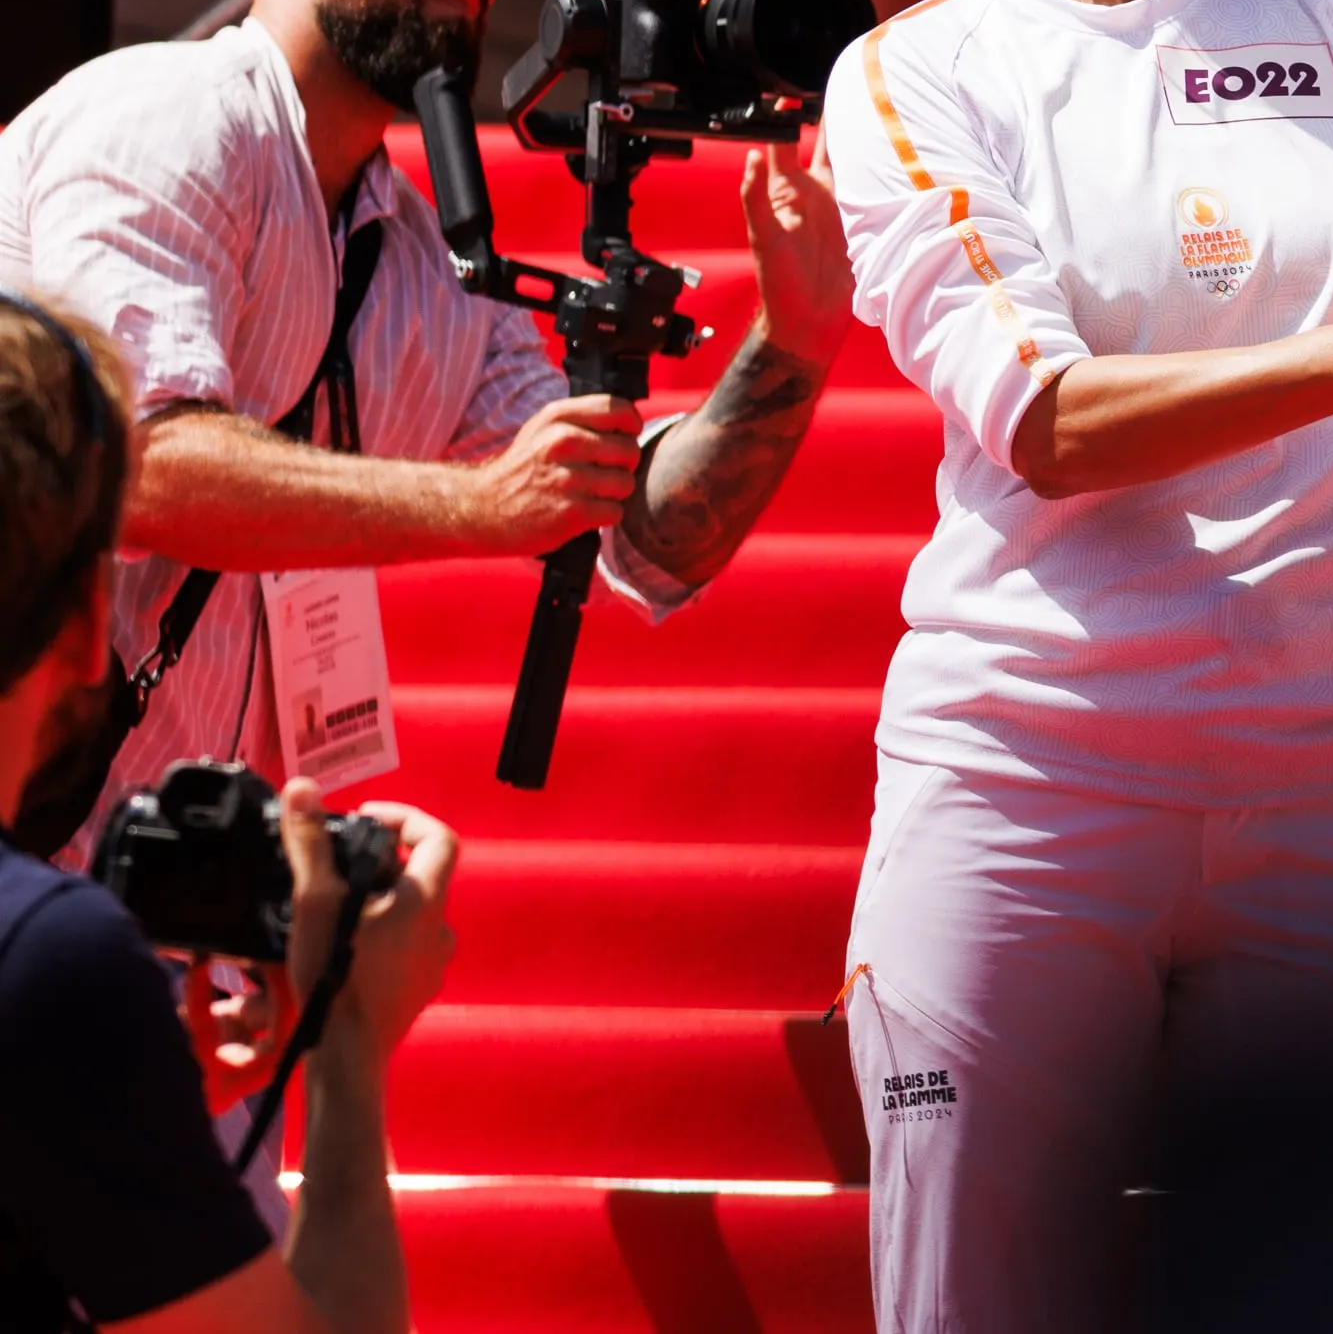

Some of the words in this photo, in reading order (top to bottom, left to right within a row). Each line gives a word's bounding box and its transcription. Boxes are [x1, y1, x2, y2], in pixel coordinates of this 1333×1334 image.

[1184, 61, 1321, 103] EO22
[1182, 231, 1223, 245] RELAIS
[1226, 228, 1242, 240] DE
[1180, 245, 1194, 257] LA
[1197, 238, 1249, 255] FLAMME
[1183, 250, 1253, 268] OLYMPIQUE
[1188, 269, 1219, 278] PARIS
[1222, 263, 1252, 275] 2024
[884, 1072, 925, 1093] RELAIS
[927, 1069, 949, 1086] DE
[882, 1094, 897, 1110] LA
[898, 1087, 957, 1109] FLAMME
[889, 1112, 913, 1124] PARIS
[917, 1108, 952, 1121] 2024
